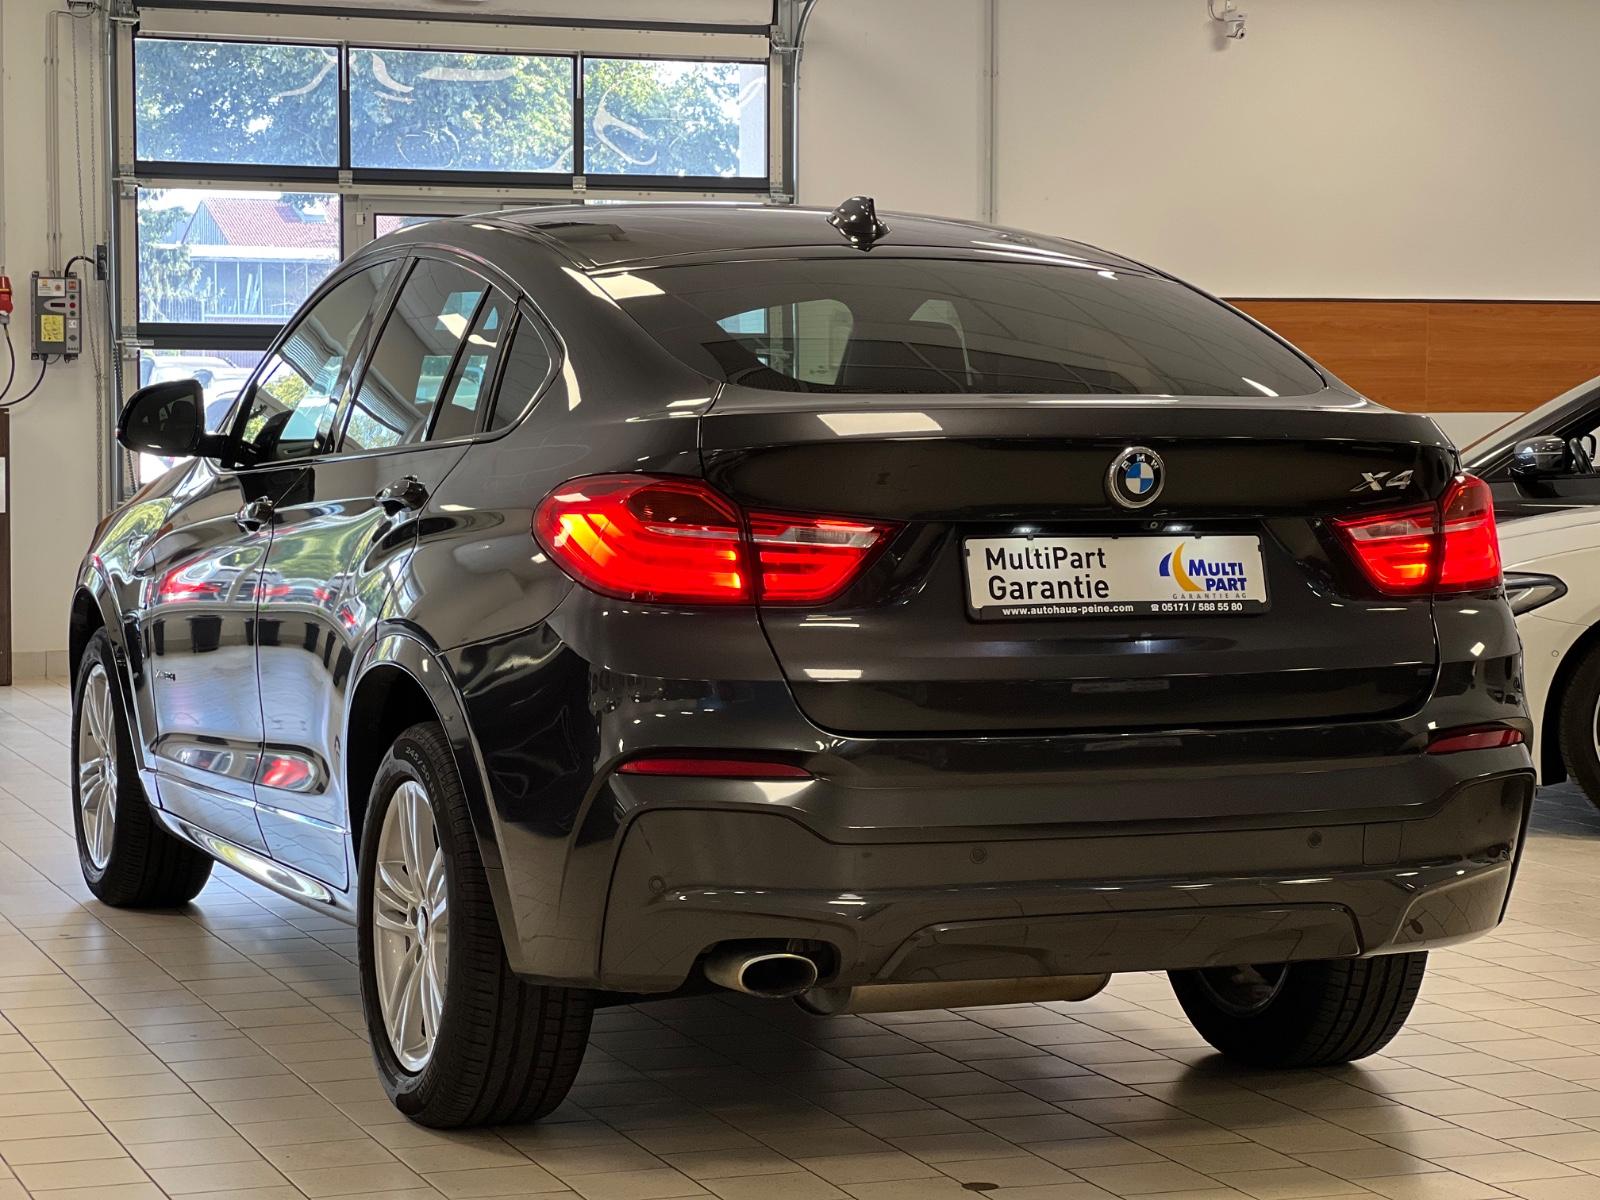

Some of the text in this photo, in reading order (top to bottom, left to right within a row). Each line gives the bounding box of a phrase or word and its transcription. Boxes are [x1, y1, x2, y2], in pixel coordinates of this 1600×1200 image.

[1121, 454, 1159, 470] BMW
[1349, 469, 1414, 491] X4
[985, 547, 1106, 570] MultiPart
[1189, 559, 1244, 576] MULTI
[988, 574, 1109, 600] Garantie
[1205, 577, 1247, 591] PART
[1002, 604, 1134, 615] www.autohaus-peine.com
[1161, 603, 1189, 611] 05171
[1198, 603, 1215, 611] 588
[1217, 603, 1229, 611] 55
[1231, 602, 1243, 611] 80
